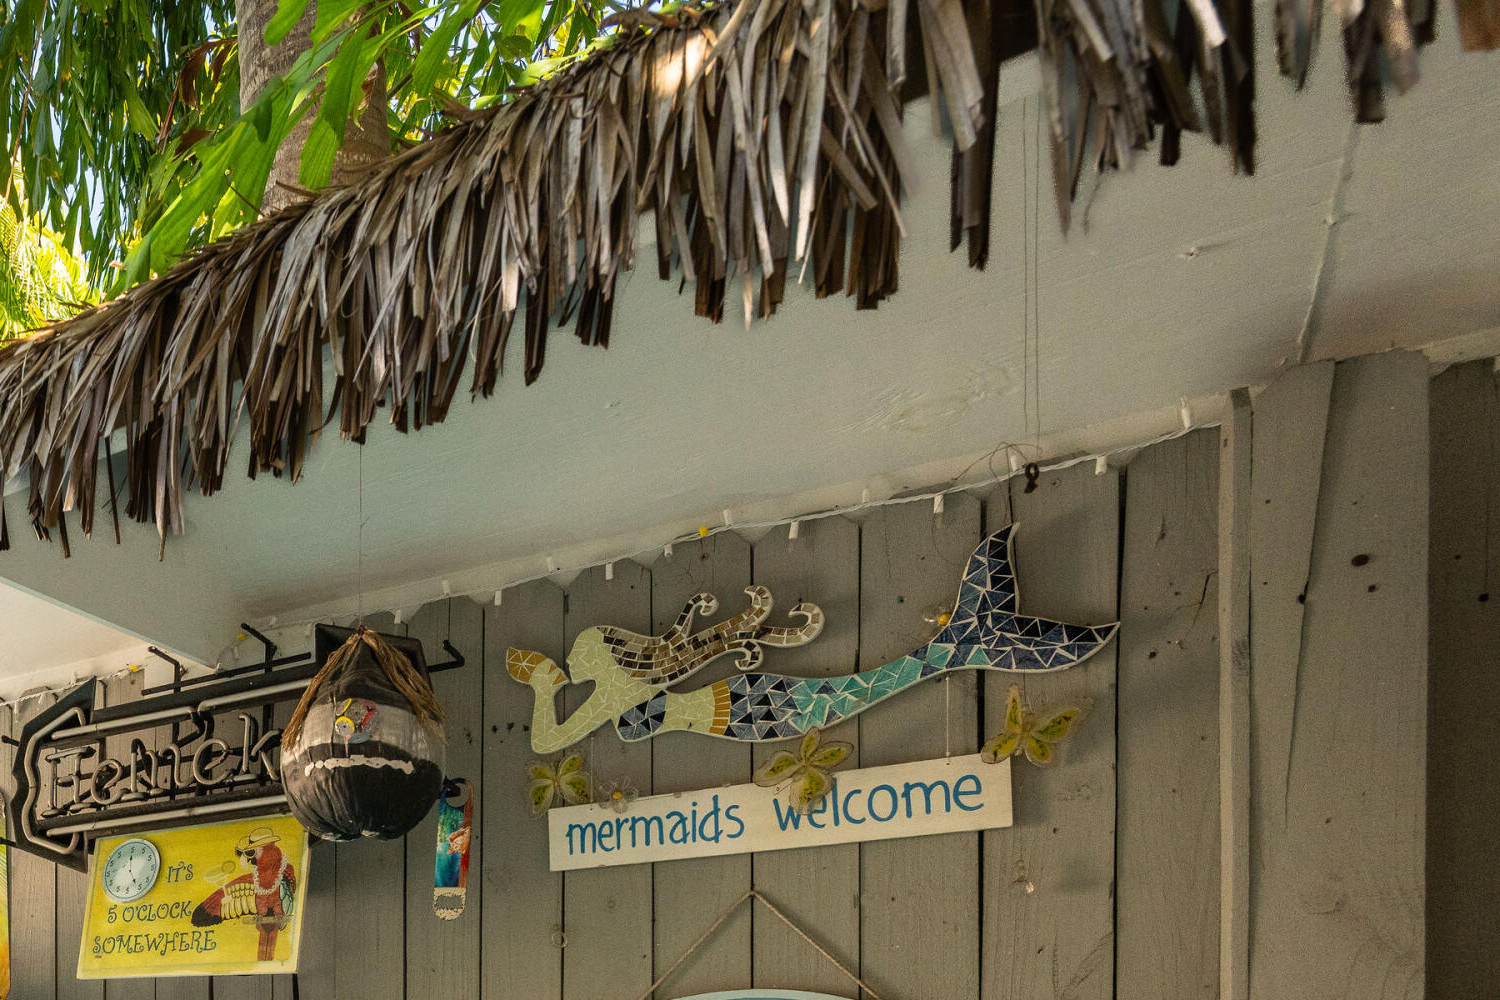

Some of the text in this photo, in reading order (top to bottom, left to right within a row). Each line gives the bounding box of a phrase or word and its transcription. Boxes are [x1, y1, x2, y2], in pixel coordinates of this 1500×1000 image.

[41, 712, 282, 818] Heinek
[566, 774, 985, 856] mermaids welcome
[166, 861, 194, 883] IT'S
[108, 901, 192, 924] 5 O'CLOCK
[93, 930, 217, 956] SOMEWHERE
